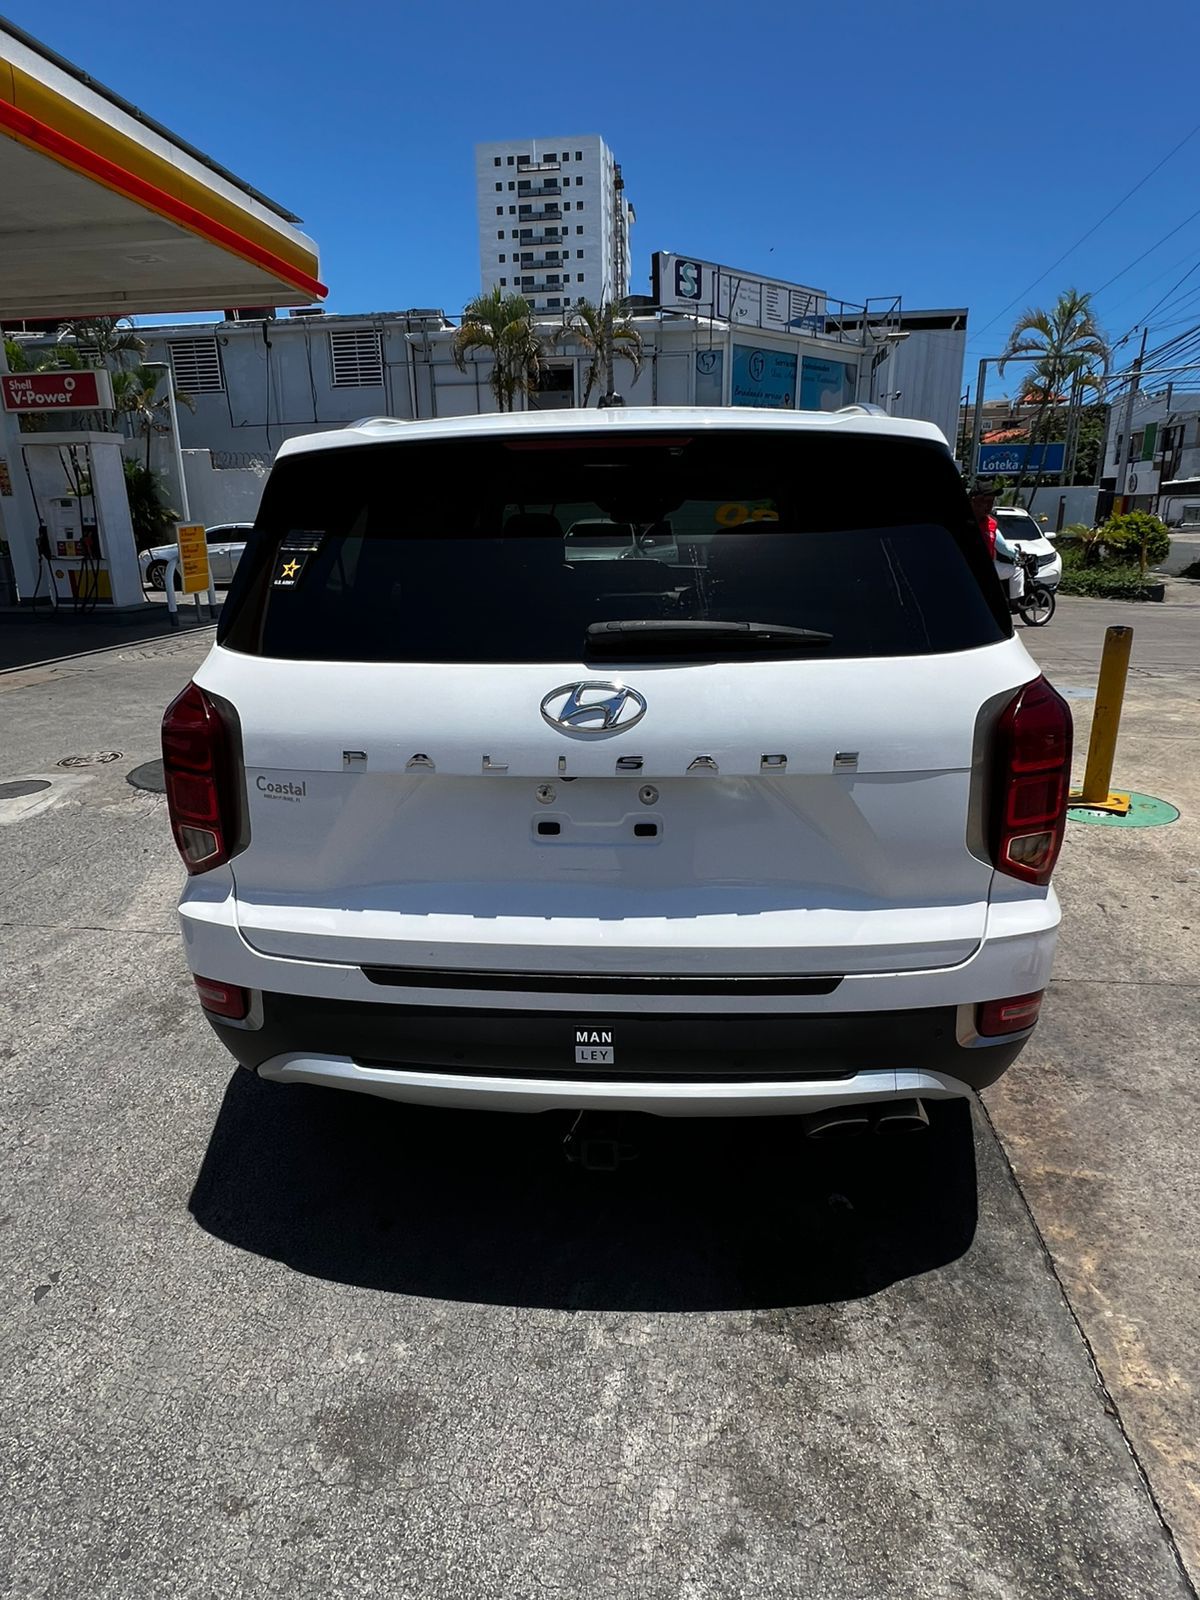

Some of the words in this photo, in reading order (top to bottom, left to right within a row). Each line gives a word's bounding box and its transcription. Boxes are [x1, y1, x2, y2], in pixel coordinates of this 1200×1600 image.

[8, 379, 33, 391] Shell
[11, 390, 73, 405] V-Power
[982, 459, 1019, 471] Loteka
[342, 749, 860, 771] PALISADE
[256, 775, 306, 797] Coastal
[576, 1031, 612, 1043] MAN
[580, 1050, 608, 1061] LEY
